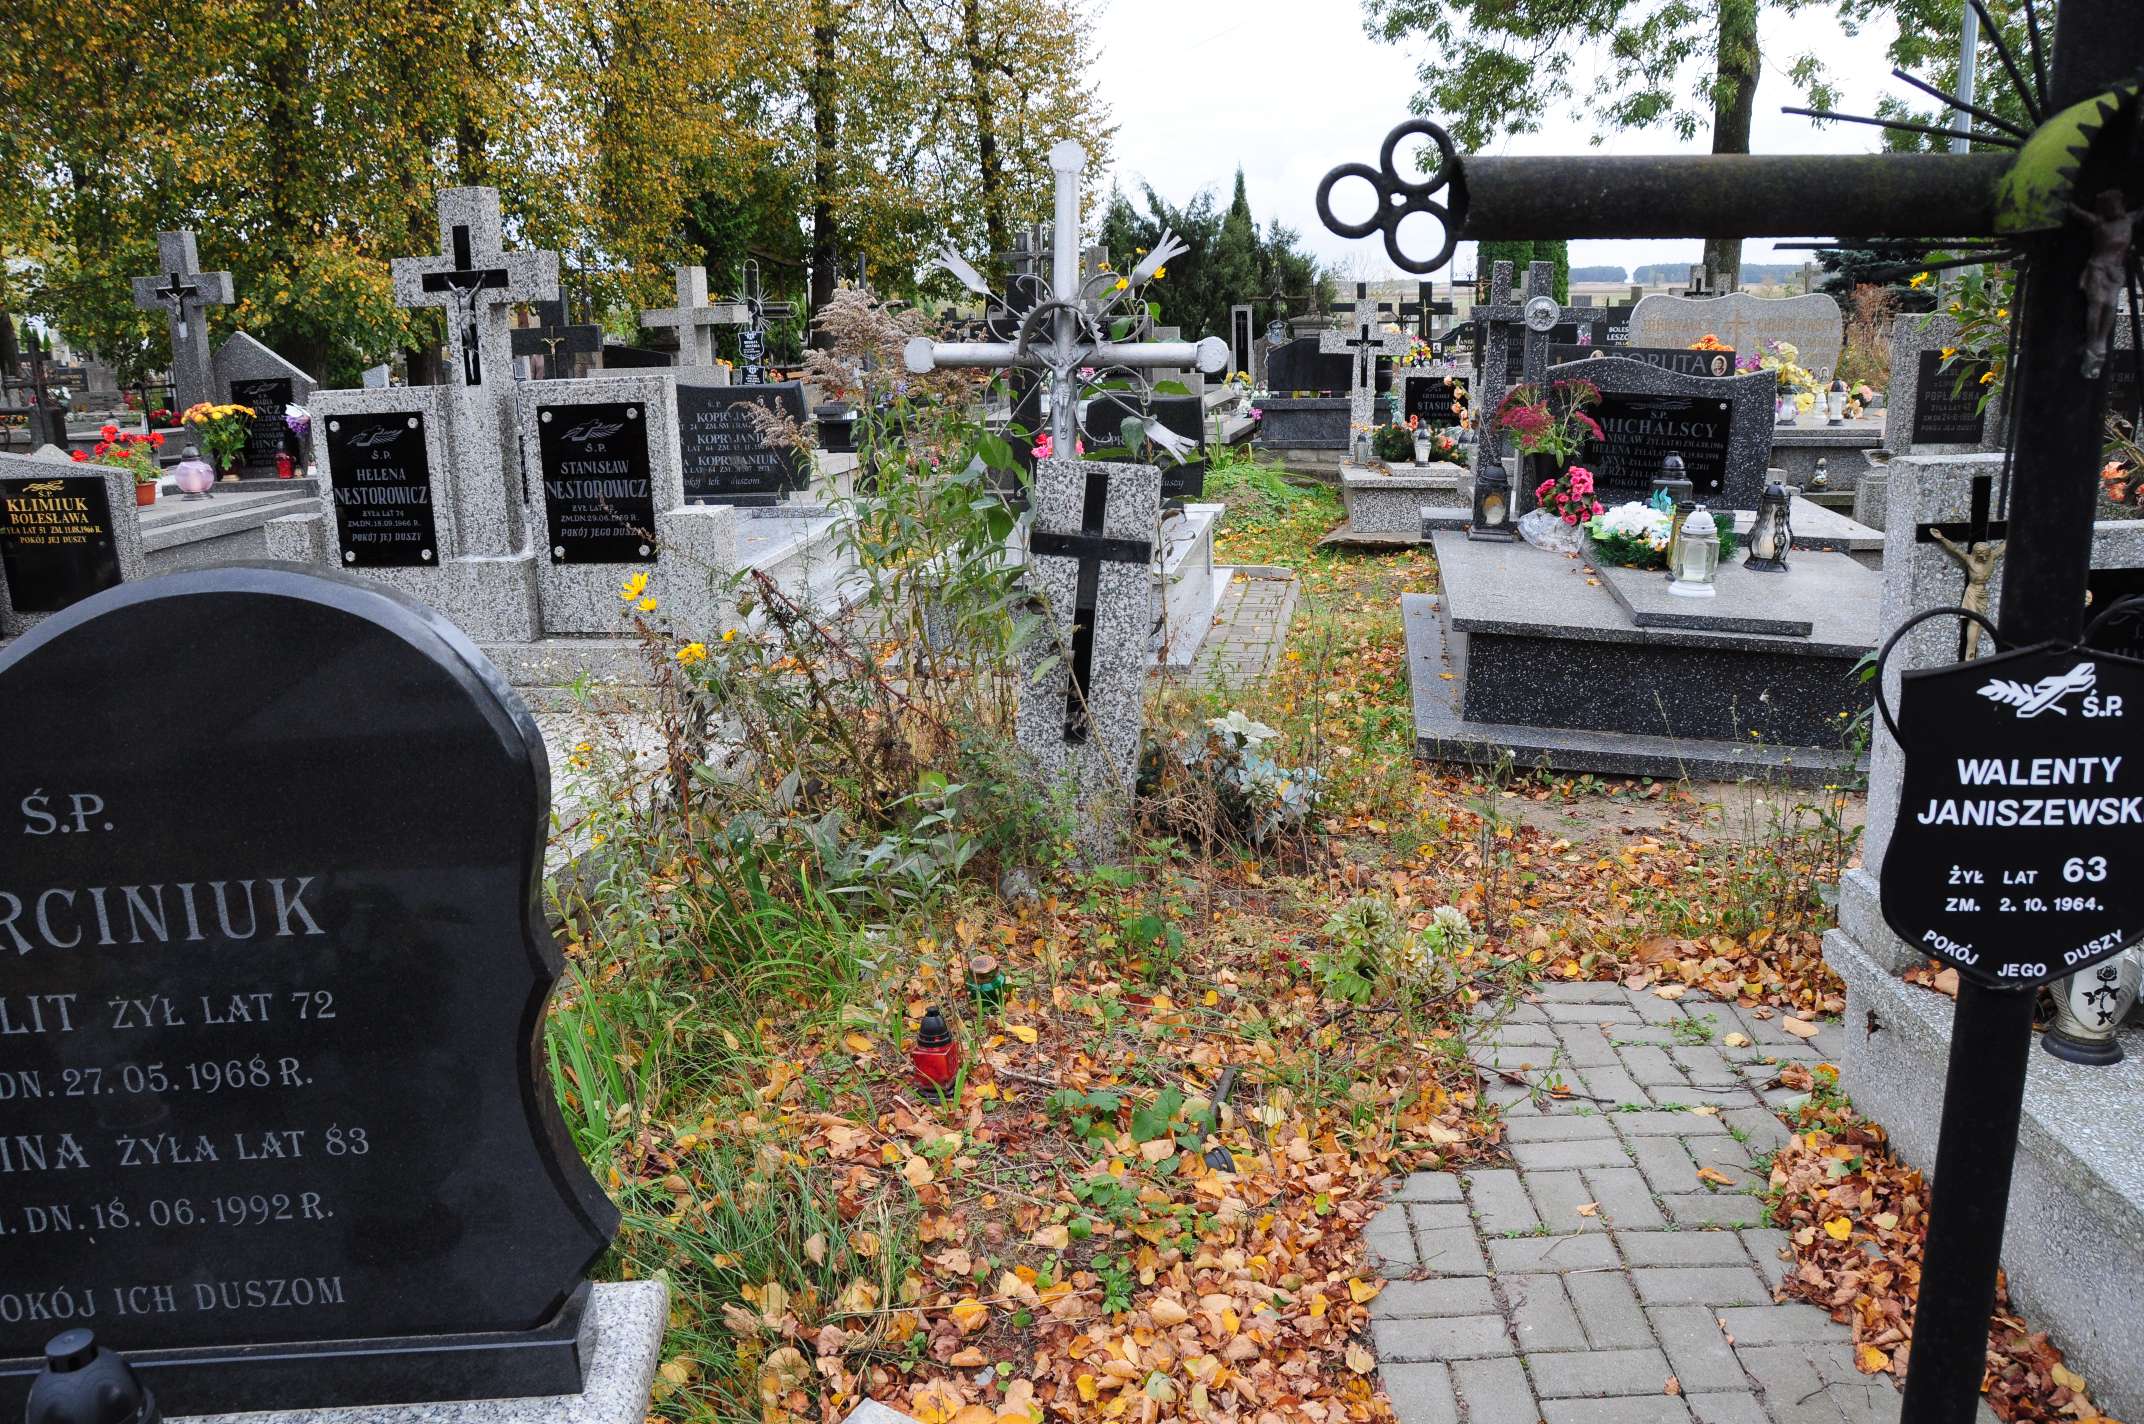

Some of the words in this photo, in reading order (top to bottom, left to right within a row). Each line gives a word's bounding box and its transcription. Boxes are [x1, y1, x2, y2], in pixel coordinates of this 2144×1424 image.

[1600, 416, 1718, 438] MICHALSCY
[356, 468, 406, 481] HELENA
[560, 460, 629, 475] STANISŁAW
[334, 486, 428, 505] NESTOROWICZ
[545, 479, 648, 499] NESTOROWICZ
[6, 497, 88, 512] KLIMIUK
[2082, 690, 2123, 717] Ś.P.
[1957, 756, 2122, 785] WALENTY
[20, 788, 114, 835] Ś.P.
[1917, 797, 2144, 826] JANISZEWSK
[1949, 864, 1984, 885] ŻYŁ
[2002, 870, 2038, 885] LAT
[2063, 856, 2107, 883] 63
[1945, 897, 1980, 912] ZM.
[1922, 929, 1979, 966] POKÓJ
[1997, 963, 2047, 977] JEGO
[2063, 929, 2123, 966] DUSZY
[107, 994, 186, 1029] ŻYŁ
[201, 992, 272, 1025] LAT
[291, 990, 336, 1020] 72
[279, 1057, 313, 1087] R.
[116, 1132, 220, 1166] ŻYŁA
[235, 1130, 305, 1160] LAT
[325, 1122, 370, 1156] 83
[24, 1205, 85, 1233] DN.
[301, 1191, 334, 1220] R.
[114, 1284, 177, 1315] ICH
[194, 1276, 345, 1310] DUSZOM
